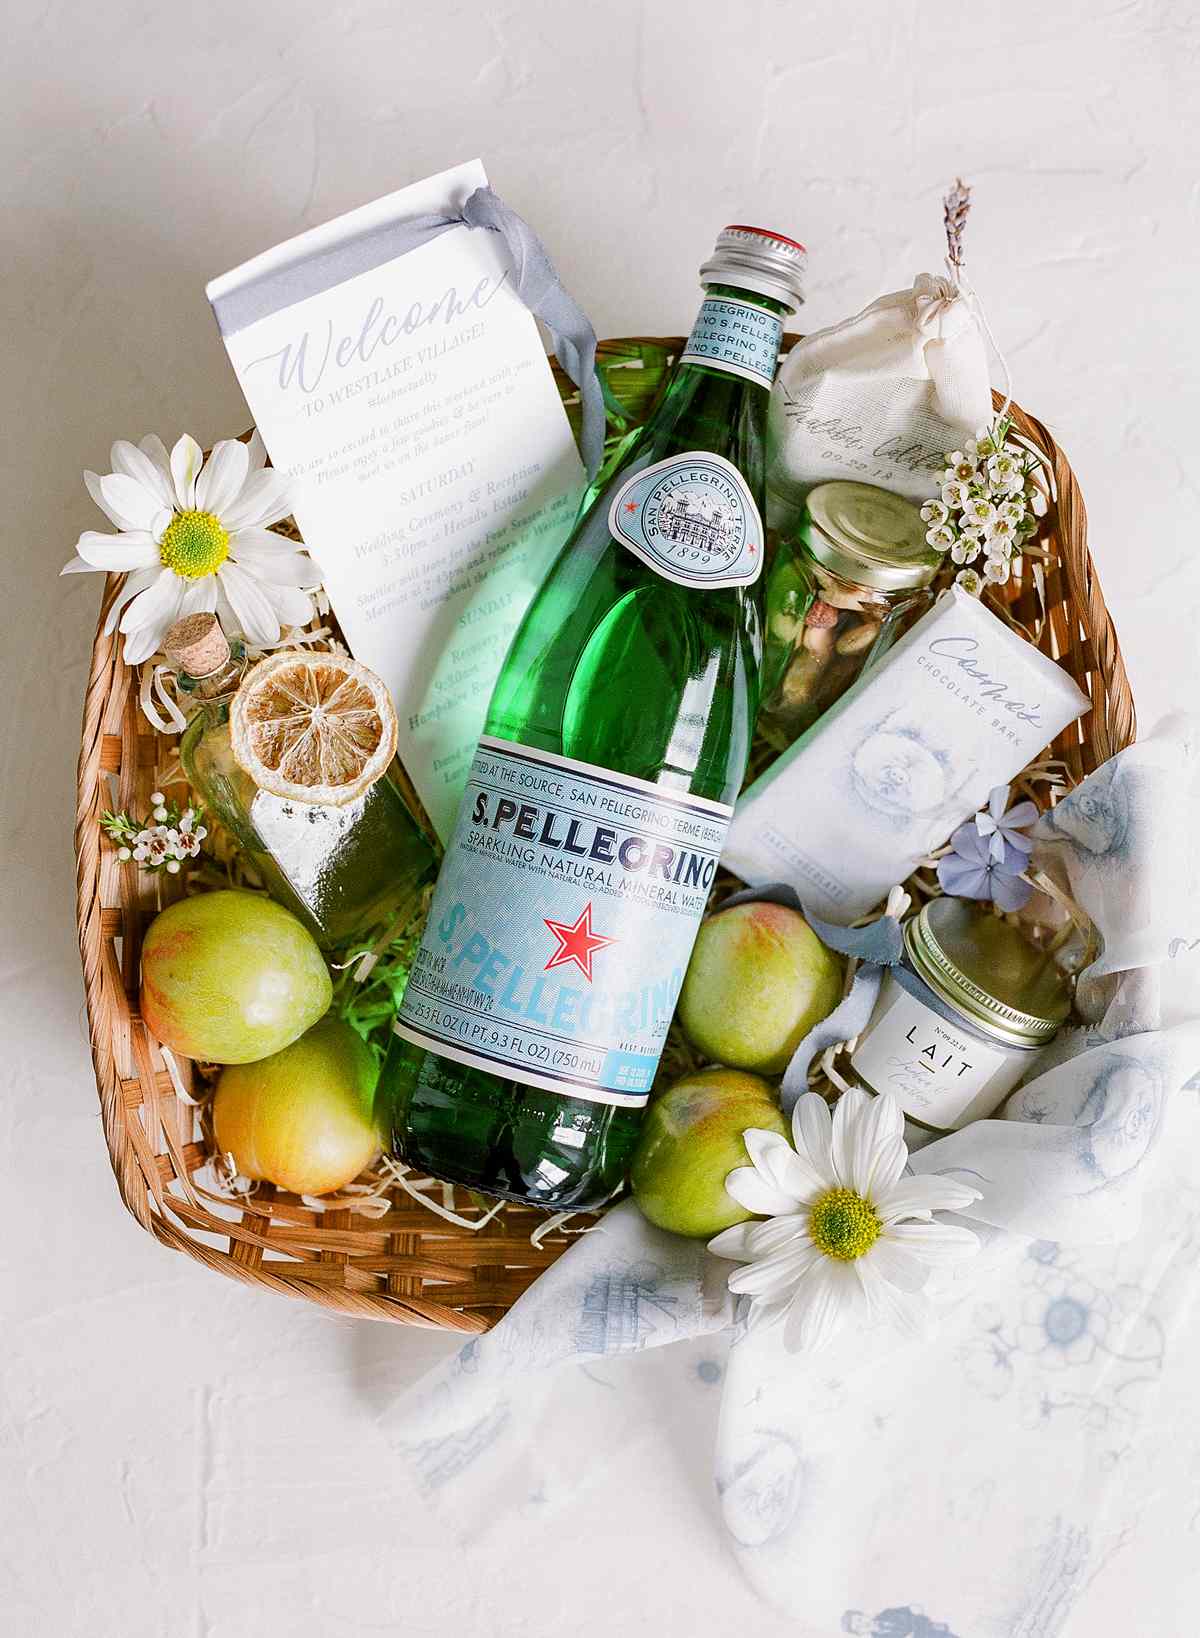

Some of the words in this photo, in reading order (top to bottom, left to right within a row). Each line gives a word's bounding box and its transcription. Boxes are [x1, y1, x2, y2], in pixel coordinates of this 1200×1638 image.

[243, 270, 509, 393] Welcome
[304, 398, 325, 417] TO
[328, 355, 413, 406] WESTLAKE
[417, 322, 487, 365] VILLAGE!
[317, 457, 352, 485] Please
[400, 458, 476, 506] SATURDAY
[492, 487, 529, 514] Estate
[353, 526, 406, 560] Wedding
[408, 497, 465, 533] Ceremony
[468, 486, 482, 503] &
[486, 463, 544, 497] Reception
[647, 506, 659, 537] SAN
[654, 472, 738, 508] PELLEGRINO
[722, 516, 742, 561] TERME
[666, 544, 711, 565] 1899
[459, 592, 513, 628] SUNDAY
[916, 655, 986, 715] CHOCOLATE
[991, 718, 1022, 746] BARK
[488, 765, 500, 777] AT
[501, 767, 517, 783] THE
[518, 773, 565, 800] SOURCE,
[570, 788, 597, 807] SAN
[600, 797, 670, 829] PELLEGRINO
[673, 819, 701, 838] TERME
[467, 831, 535, 863] SPARKLING
[540, 854, 613, 888] NATURAL
[618, 879, 677, 905] MINERAL
[505, 857, 527, 870] WATER
[528, 863, 546, 876] WITH
[547, 872, 581, 887] NATURAL
[431, 1008, 442, 1026] FL
[442, 1014, 460, 1031] OZ
[460, 1020, 470, 1035] (1
[471, 1024, 488, 1043] PT,
[491, 1031, 510, 1048] 9.3
[511, 1037, 525, 1054] FL
[528, 1042, 551, 1063] OZ)
[552, 1049, 579, 1068] (750
[905, 1025, 973, 1077] LAIT
